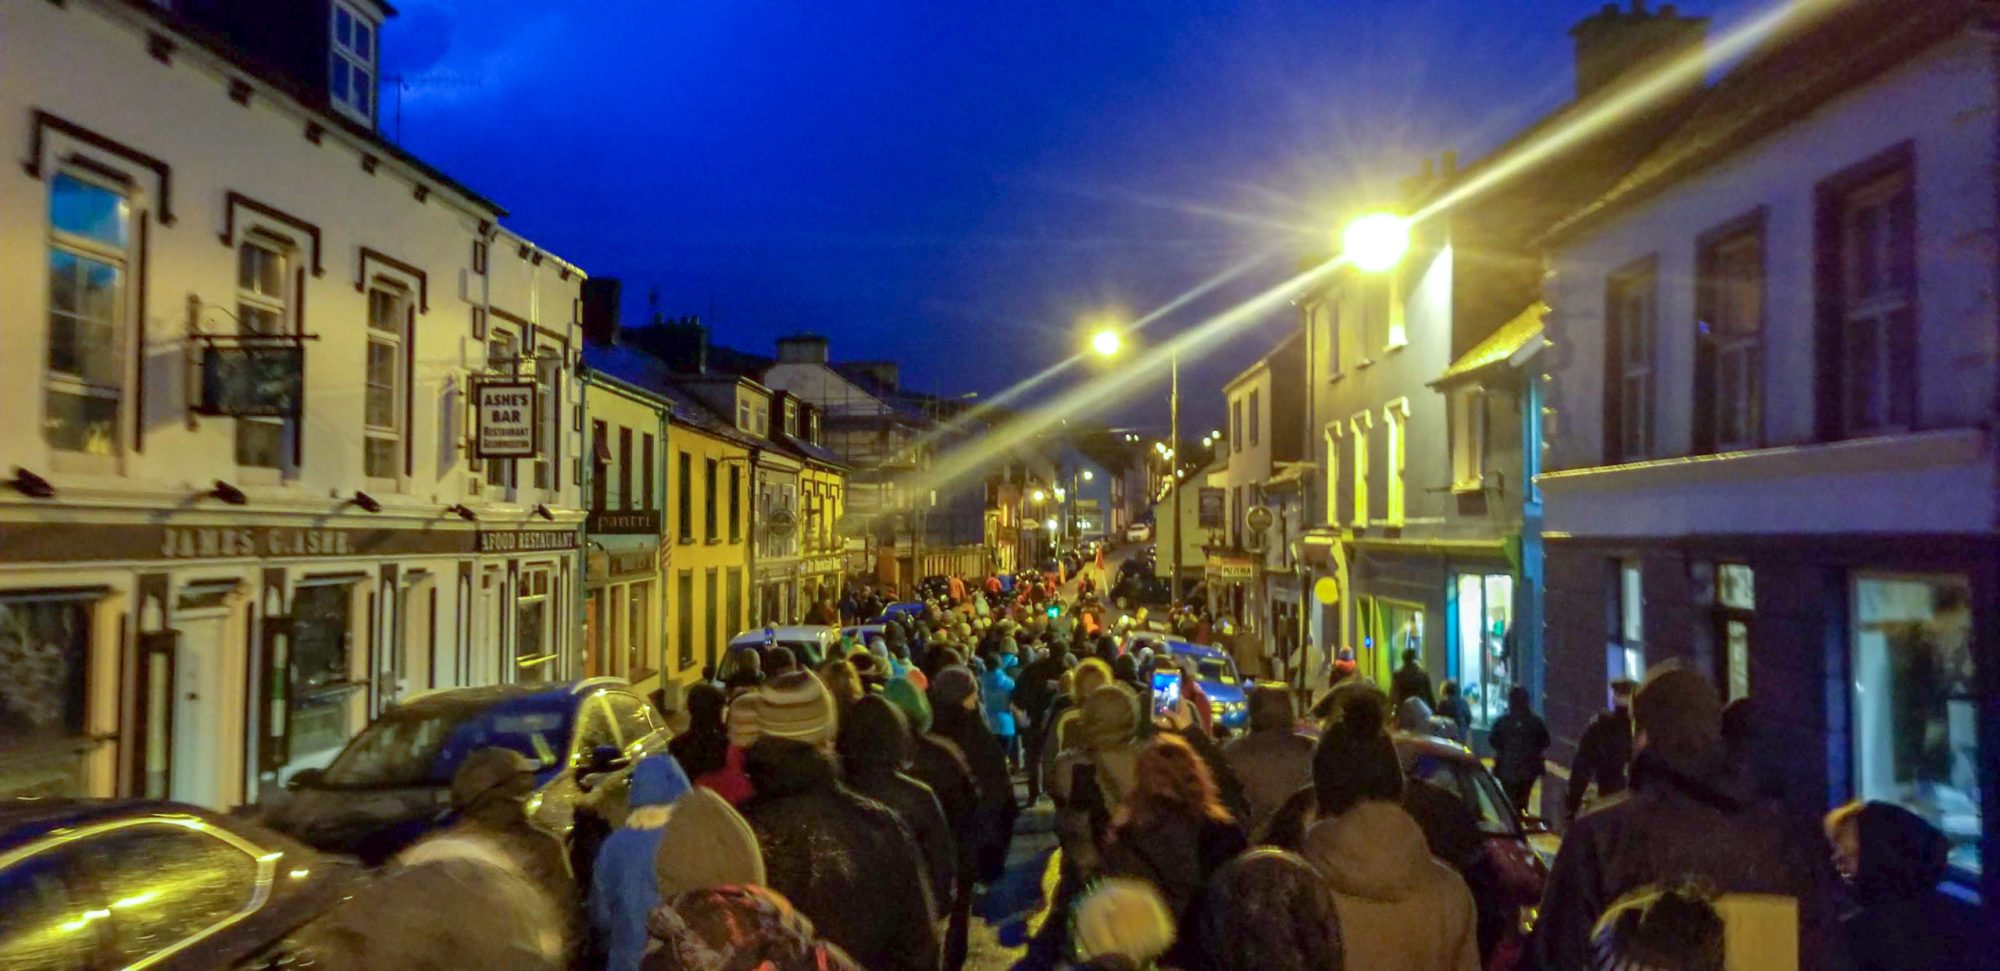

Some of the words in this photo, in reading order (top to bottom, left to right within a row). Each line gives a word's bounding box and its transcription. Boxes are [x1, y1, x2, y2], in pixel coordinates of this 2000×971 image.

[484, 393, 529, 406] ASHE'S
[492, 410, 521, 423] BAR
[598, 515, 651, 533] pantri
[161, 527, 254, 557] JAMES
[518, 532, 574, 549] RESTAURANT
[1223, 567, 1251, 575] PIZZERIA
